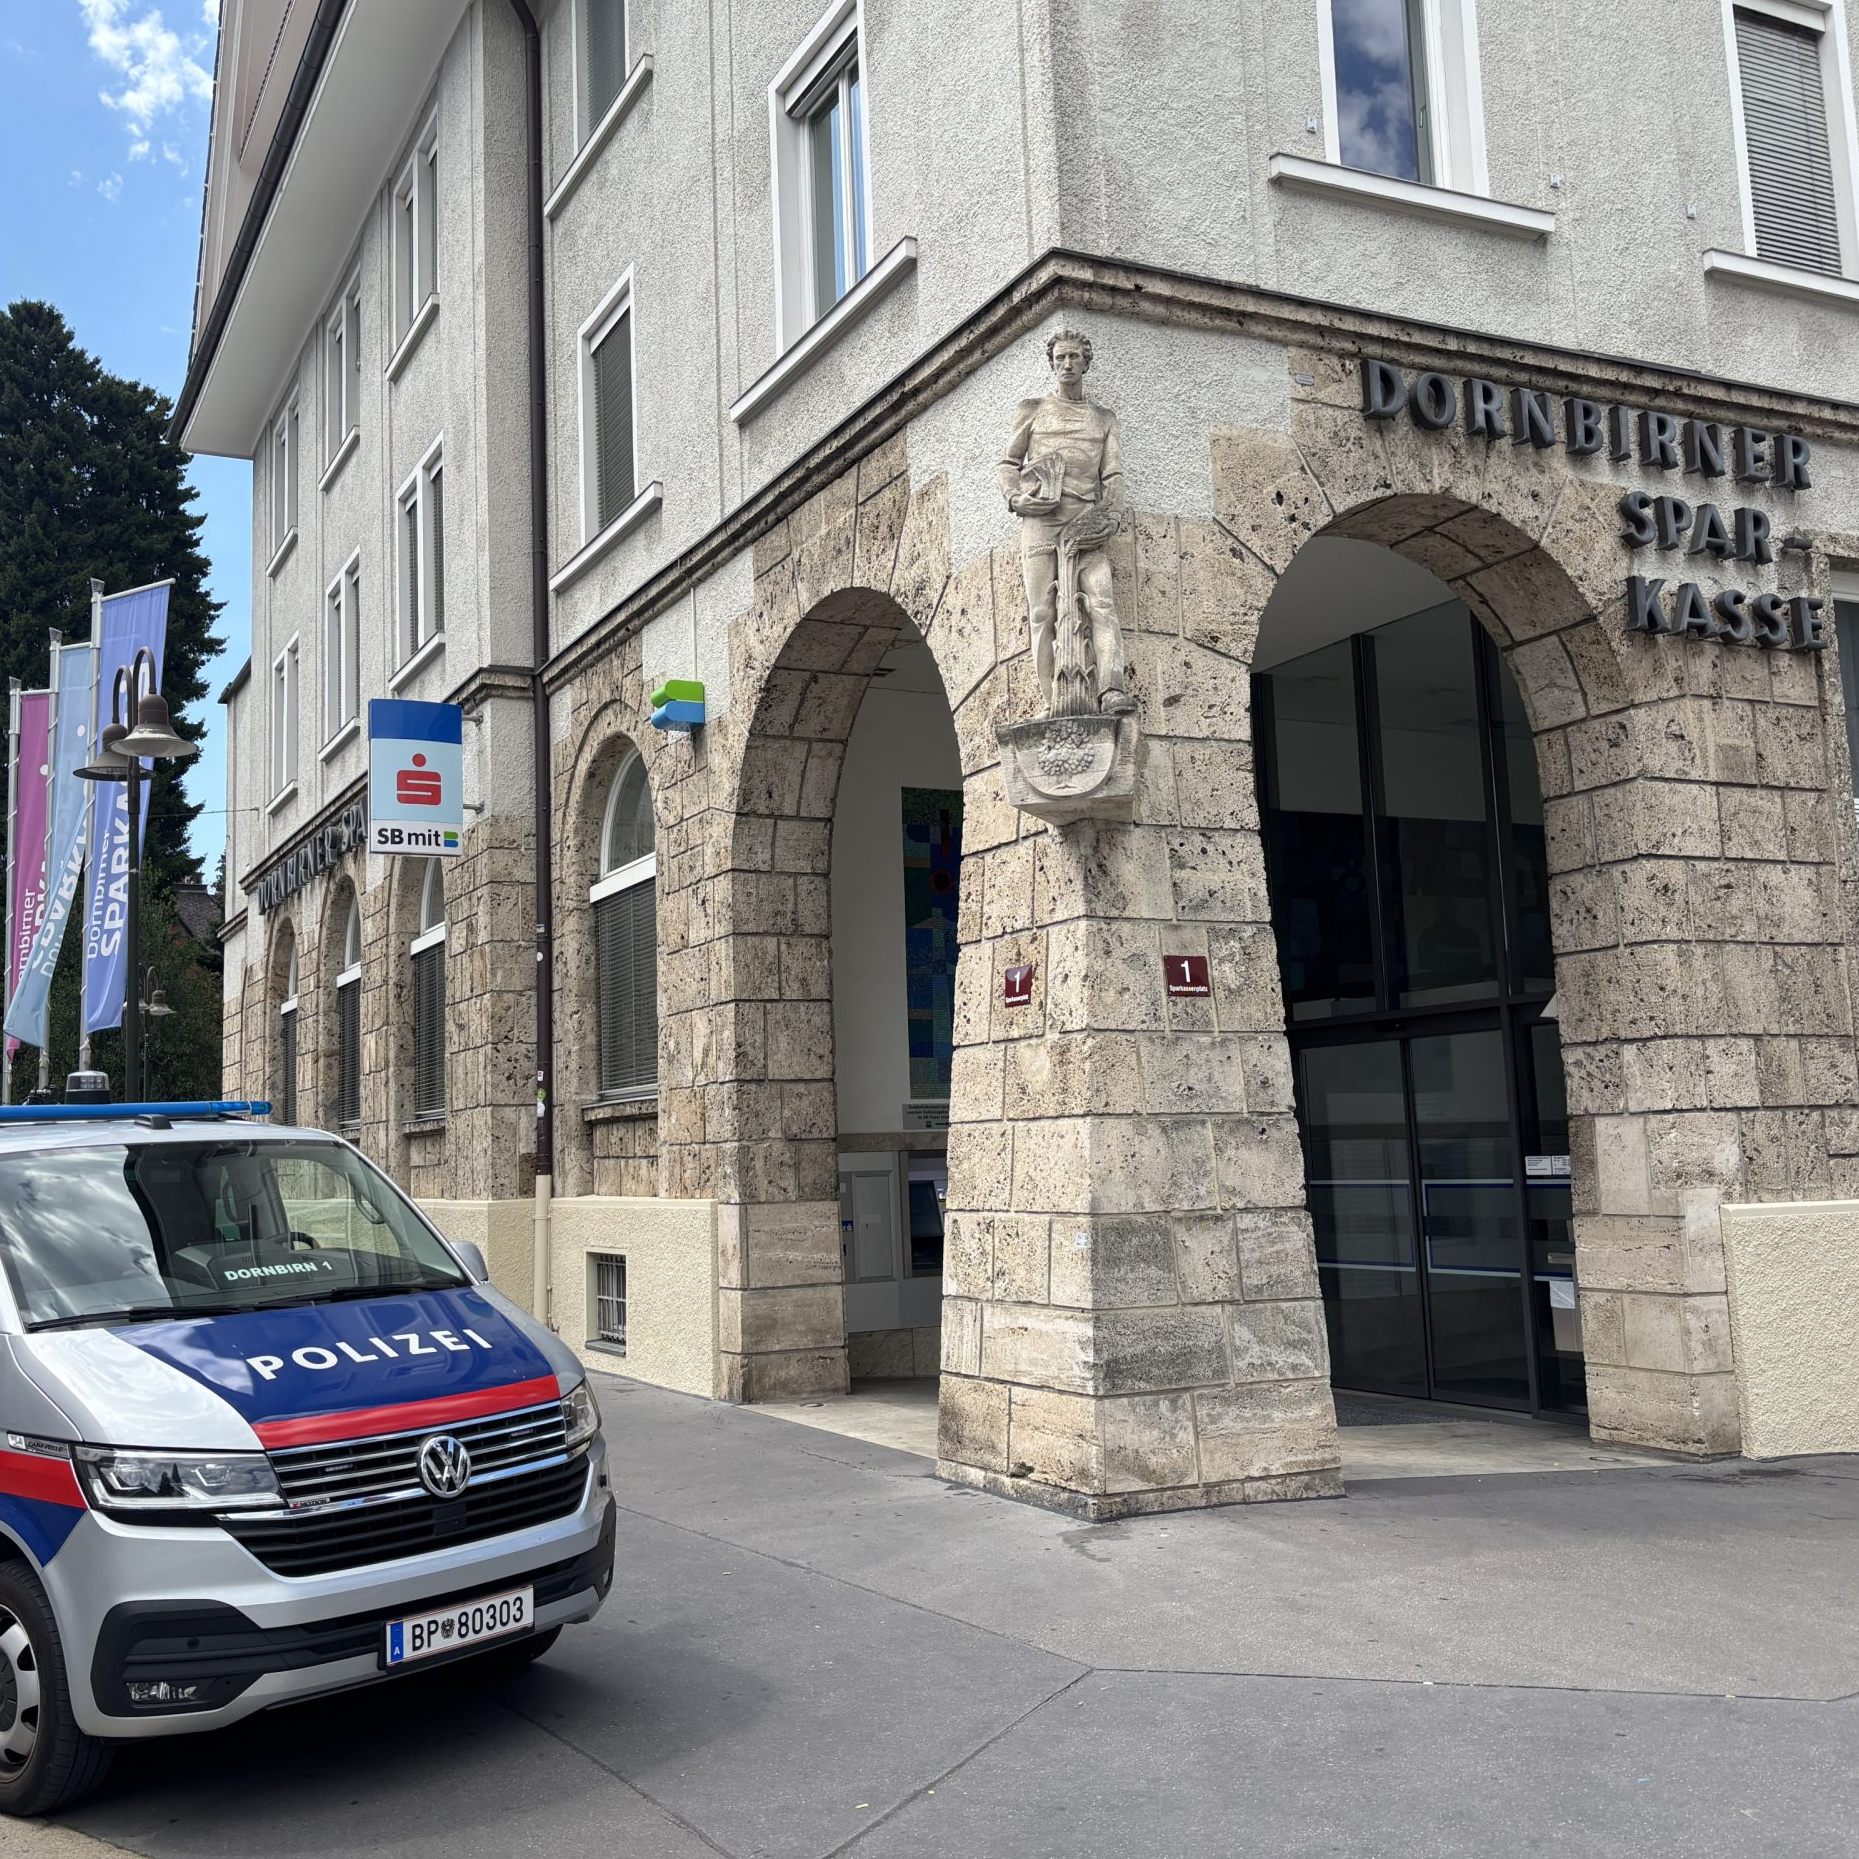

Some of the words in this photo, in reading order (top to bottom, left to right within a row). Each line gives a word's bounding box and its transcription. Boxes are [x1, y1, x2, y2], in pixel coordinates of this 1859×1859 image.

[1360, 358, 1813, 491] DORNBIRNER
[1626, 575, 1828, 651] KASSE
[377, 827, 404, 845] SB
[407, 828, 441, 847] mit
[257, 826, 340, 916] DORNBIRNER
[1014, 970, 1021, 993] 1
[1180, 960, 1191, 983] 1
[224, 1262, 318, 1281] DORNBIRN
[322, 1261, 333, 1271] 1
[246, 1329, 492, 1380] POLIZEI
[411, 1619, 439, 1652] BP
[457, 1596, 524, 1639] 80303
[393, 1646, 401, 1656] A
